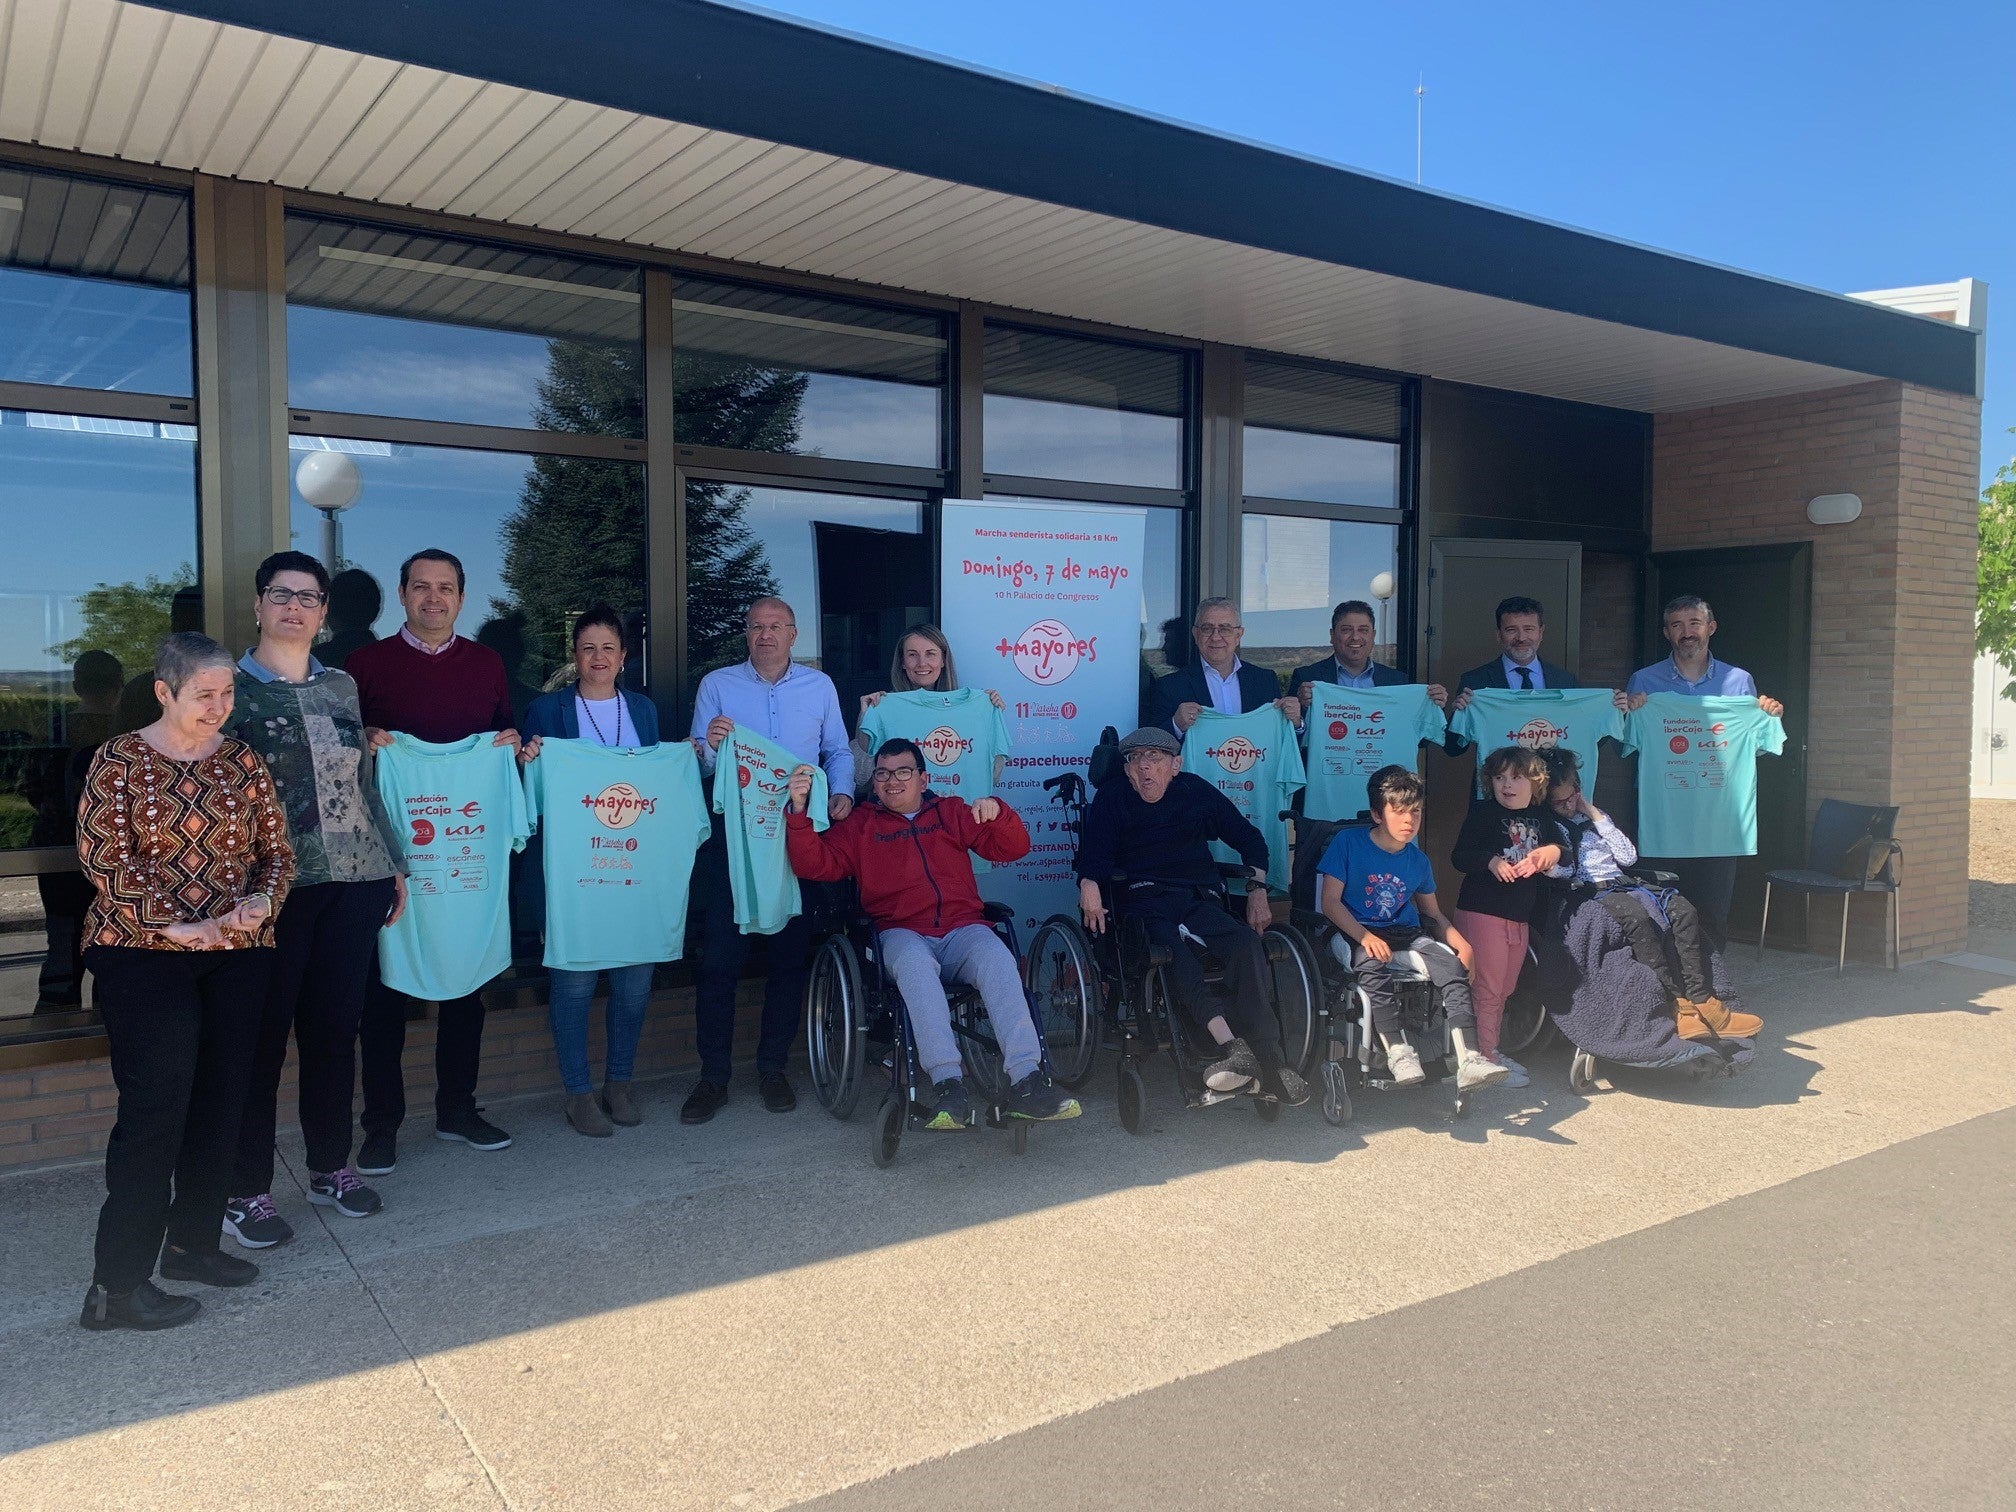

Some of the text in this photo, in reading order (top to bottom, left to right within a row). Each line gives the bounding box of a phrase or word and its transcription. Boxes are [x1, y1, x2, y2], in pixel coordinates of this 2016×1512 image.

[975, 529, 1007, 538] Marcha
[1009, 531, 1053, 540] senderista
[1055, 532, 1091, 541] solidaria
[1104, 534, 1118, 542] Km
[963, 556, 1129, 589] Domingo, 7 de mayo
[1006, 591, 1012, 599] h
[1014, 591, 1043, 600] Palacio
[1044, 592, 1055, 600] de
[1057, 592, 1100, 602] Congresos
[1015, 702, 1029, 718] 11
[1324, 703, 1361, 711] Fundación
[1007, 779, 1041, 790] gratuita
[1217, 779, 1225, 790] 11
[591, 836, 601, 849] 11
